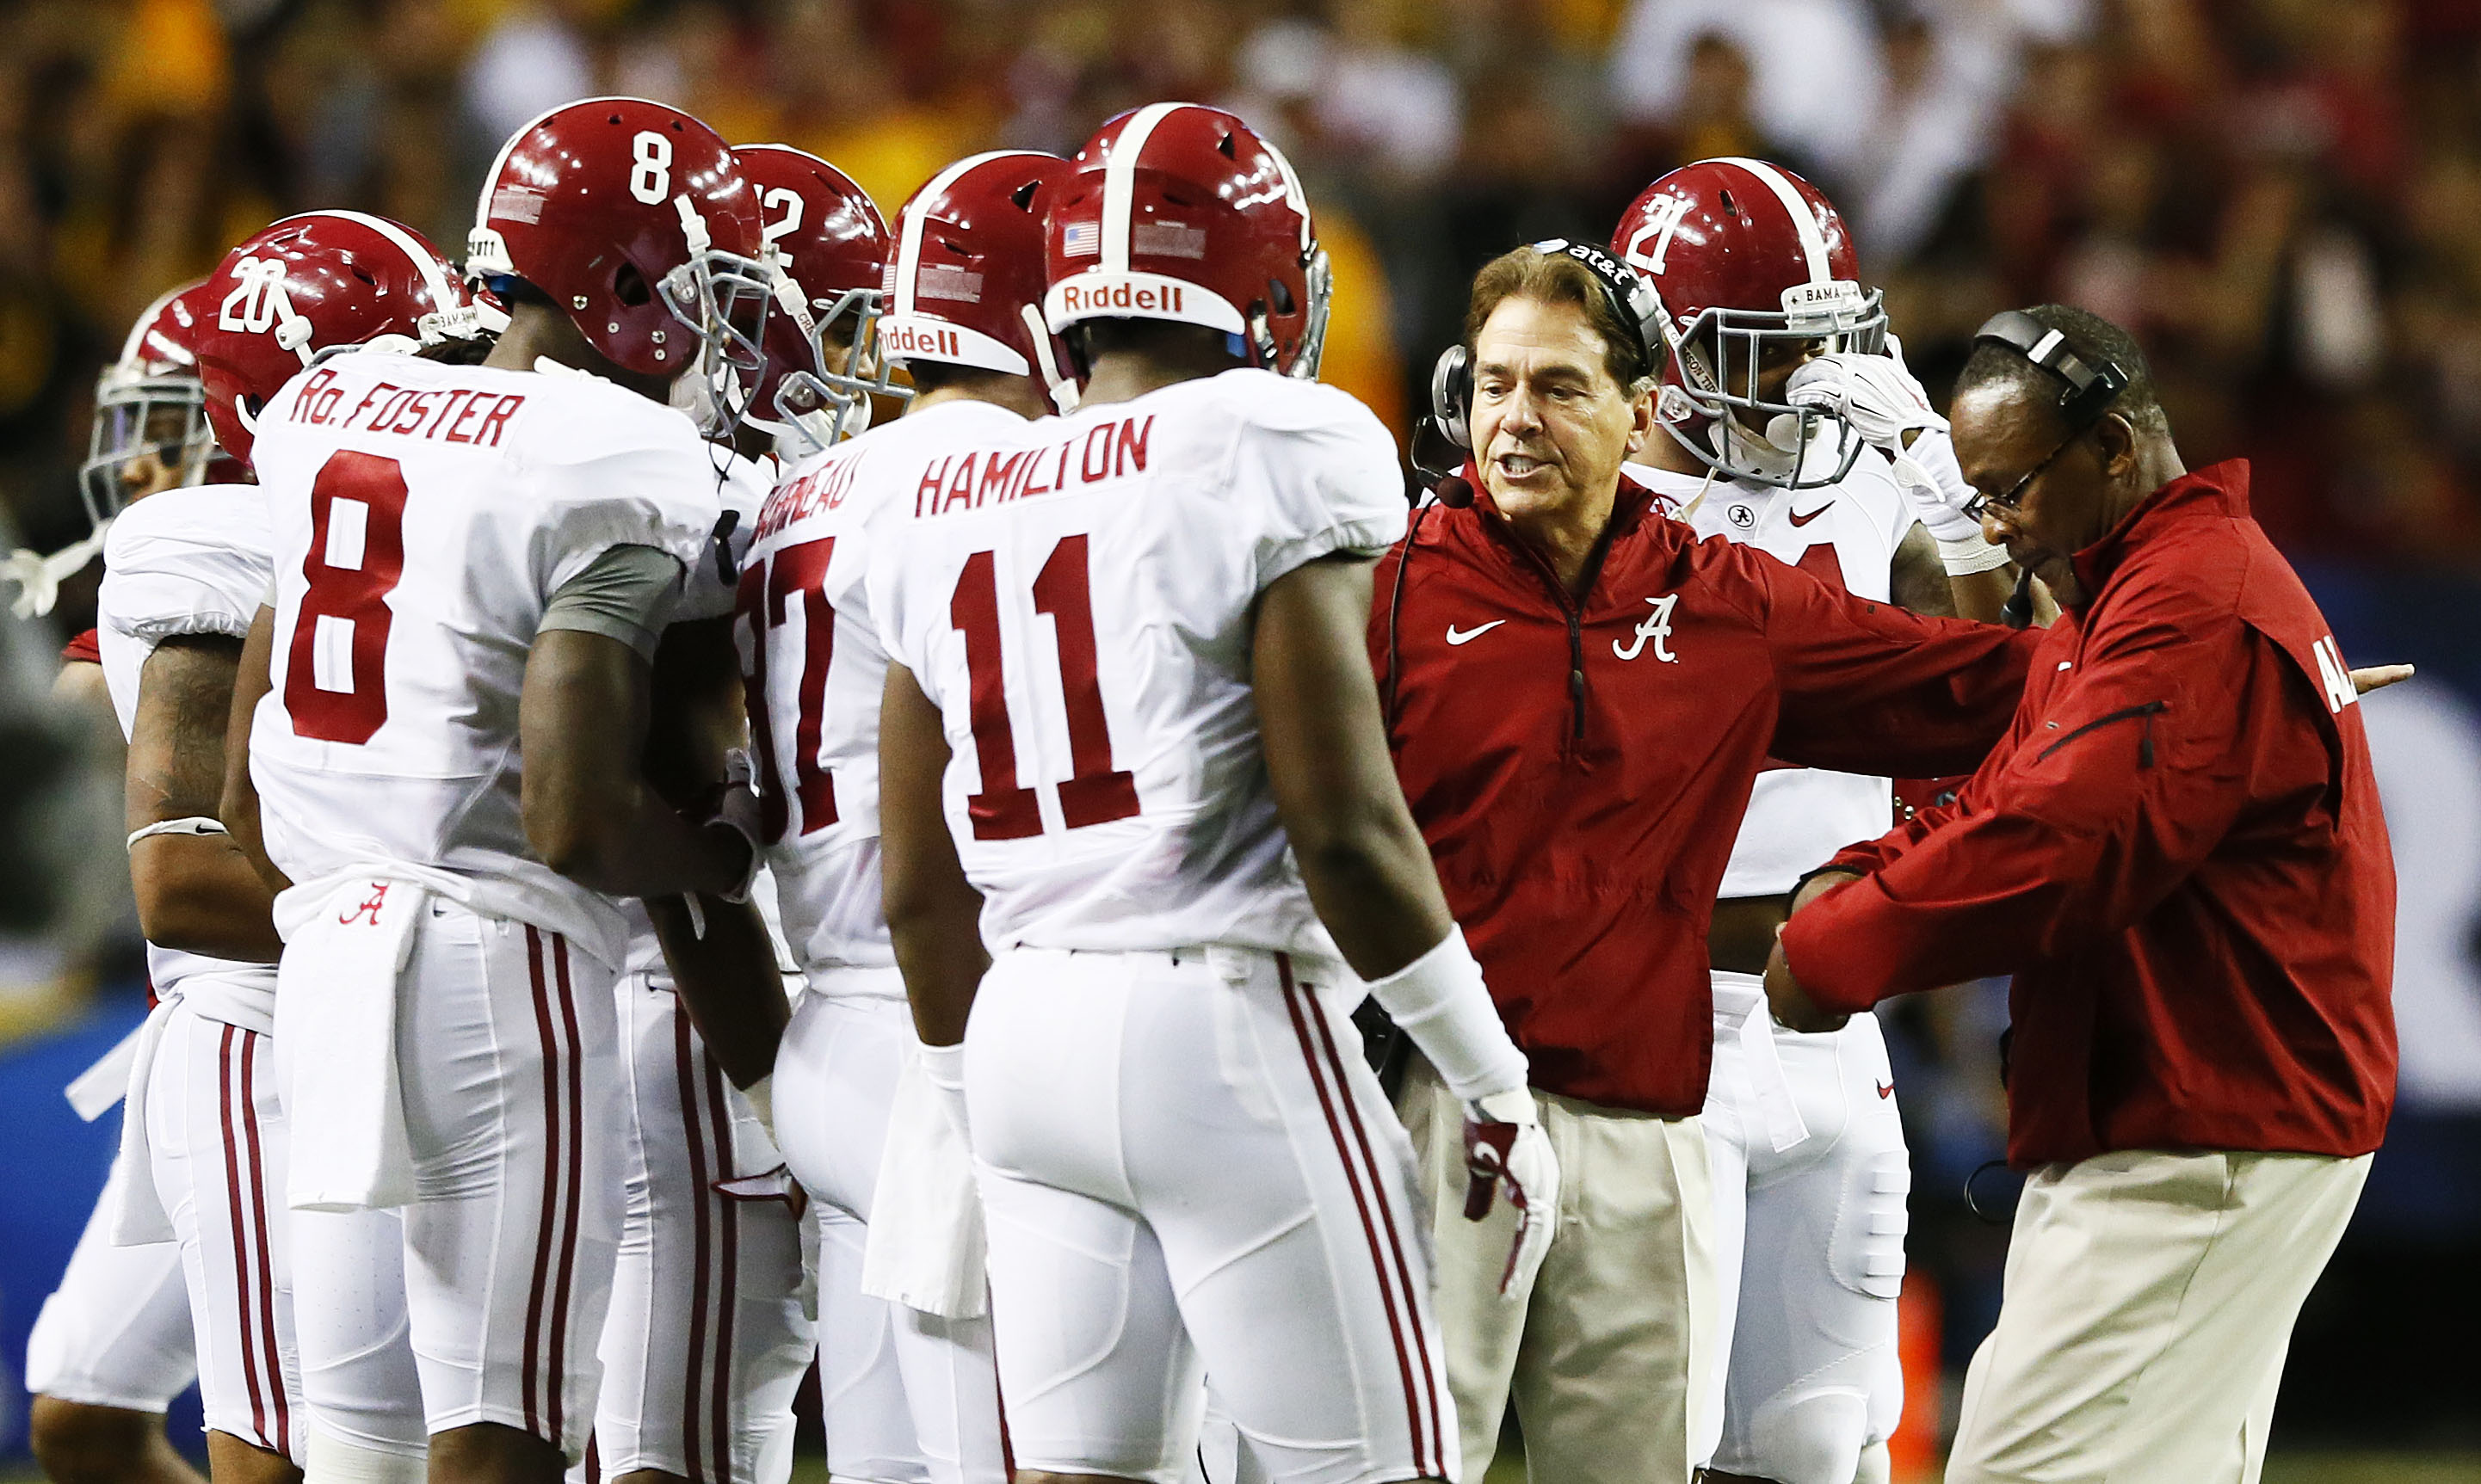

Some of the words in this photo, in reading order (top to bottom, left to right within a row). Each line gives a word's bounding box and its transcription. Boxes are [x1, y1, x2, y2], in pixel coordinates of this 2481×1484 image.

[630, 130, 673, 206] 8
[1569, 244, 1629, 286] at&t
[1625, 193, 1694, 275] 21
[219, 256, 287, 334] 20
[1065, 282, 1182, 313] Riddell
[1805, 286, 1841, 301] BAMA
[289, 368, 345, 425] Ro.
[343, 382, 526, 447] FOSTER
[915, 414, 1157, 518] HAMILTON
[283, 449, 409, 746] 8
[951, 533, 1141, 841] 11
[2312, 634, 2358, 714] AL
